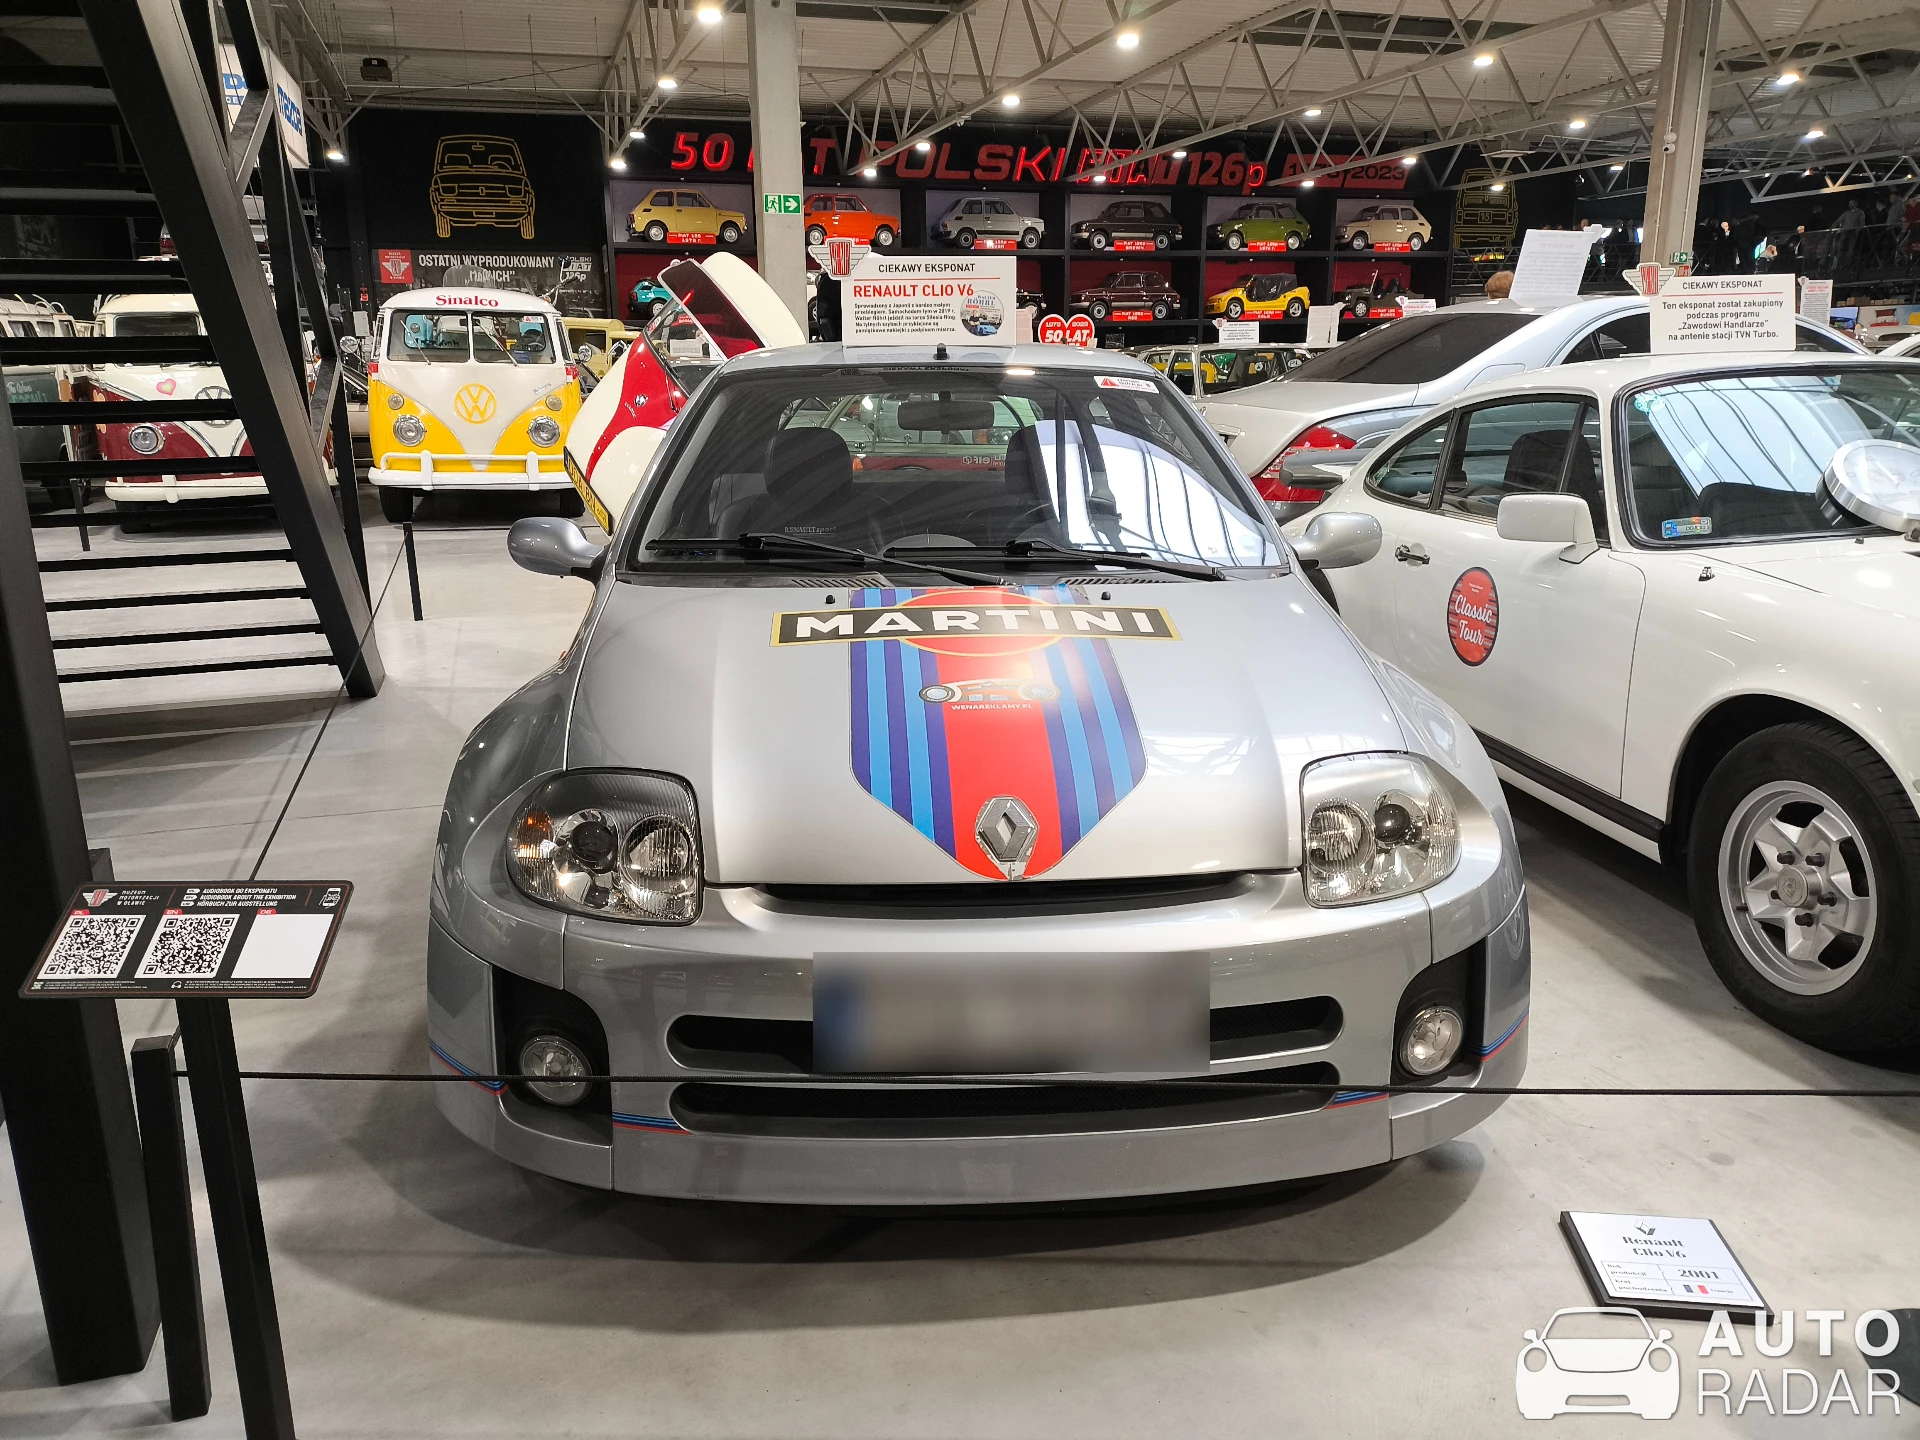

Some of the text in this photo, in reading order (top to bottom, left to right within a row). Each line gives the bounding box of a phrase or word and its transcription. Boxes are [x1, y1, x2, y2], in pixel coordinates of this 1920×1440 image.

[671, 132, 734, 171] 50
[857, 139, 1067, 182] POLSKI
[1077, 148, 1184, 185] FIAT
[1187, 151, 1268, 195] 126p
[1350, 164, 1405, 181] 2023
[418, 254, 461, 267] OSTATNI
[463, 255, 555, 269] WYPRODUKOWANY
[878, 263, 976, 273] CIEKAWY EKSPONAT
[853, 283, 974, 298] RENAULT CLIO V6
[1682, 280, 1763, 290] CIEKAWY EKSPONAT
[435, 294, 499, 308] Sinalco
[1662, 299, 1784, 311] Ten eksponat został zakupiony
[1686, 310, 1760, 321] podczas programu
[1678, 319, 1770, 331] „Zawodowi Handlarze”
[1044, 329, 1090, 343] 50 LAT
[1679, 332, 1710, 341] antenie
[1711, 331, 1733, 341] stacji
[1735, 330, 1751, 339] TVN
[1752, 330, 1779, 339] Turbo.
[1454, 594, 1493, 624] Classic
[795, 609, 1154, 638] MARTINI
[1459, 619, 1485, 646] Tour
[951, 703, 1033, 711] WENAREKLAMY.PL
[1622, 1236, 1685, 1248] Renault
[1632, 1247, 1687, 1259] Clio V6
[1677, 1269, 1720, 1280] 2001
